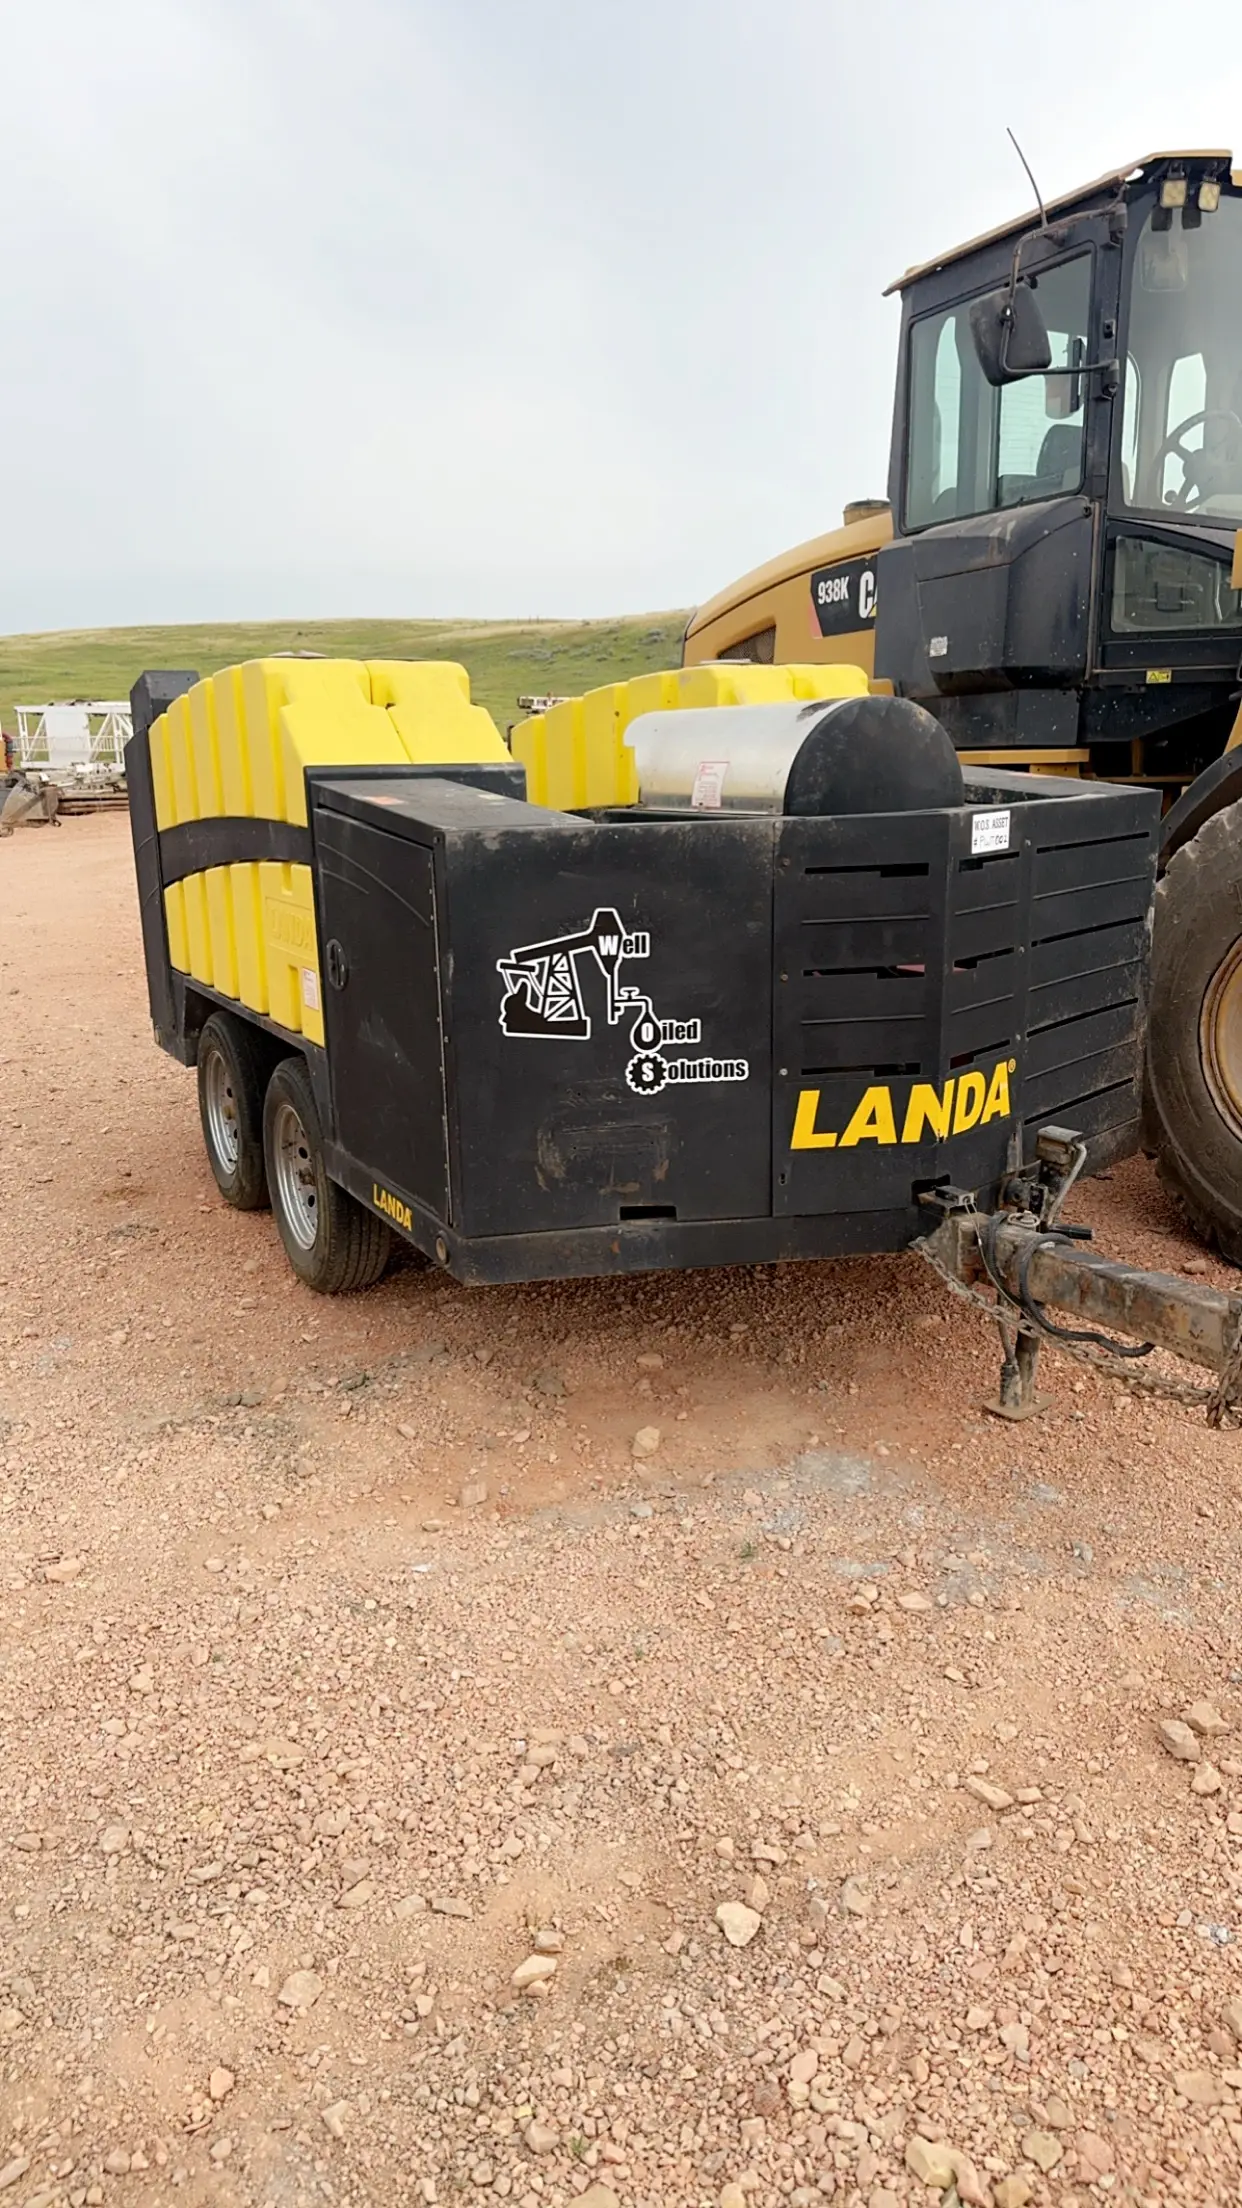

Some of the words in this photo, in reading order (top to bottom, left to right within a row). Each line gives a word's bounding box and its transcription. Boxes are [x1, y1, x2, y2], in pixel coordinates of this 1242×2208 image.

[818, 576, 849, 604] 938K
[992, 816, 1009, 829] ASSET
[598, 932, 649, 957] Well
[640, 1018, 701, 1043] Oiled
[641, 1058, 749, 1083] Solutions
